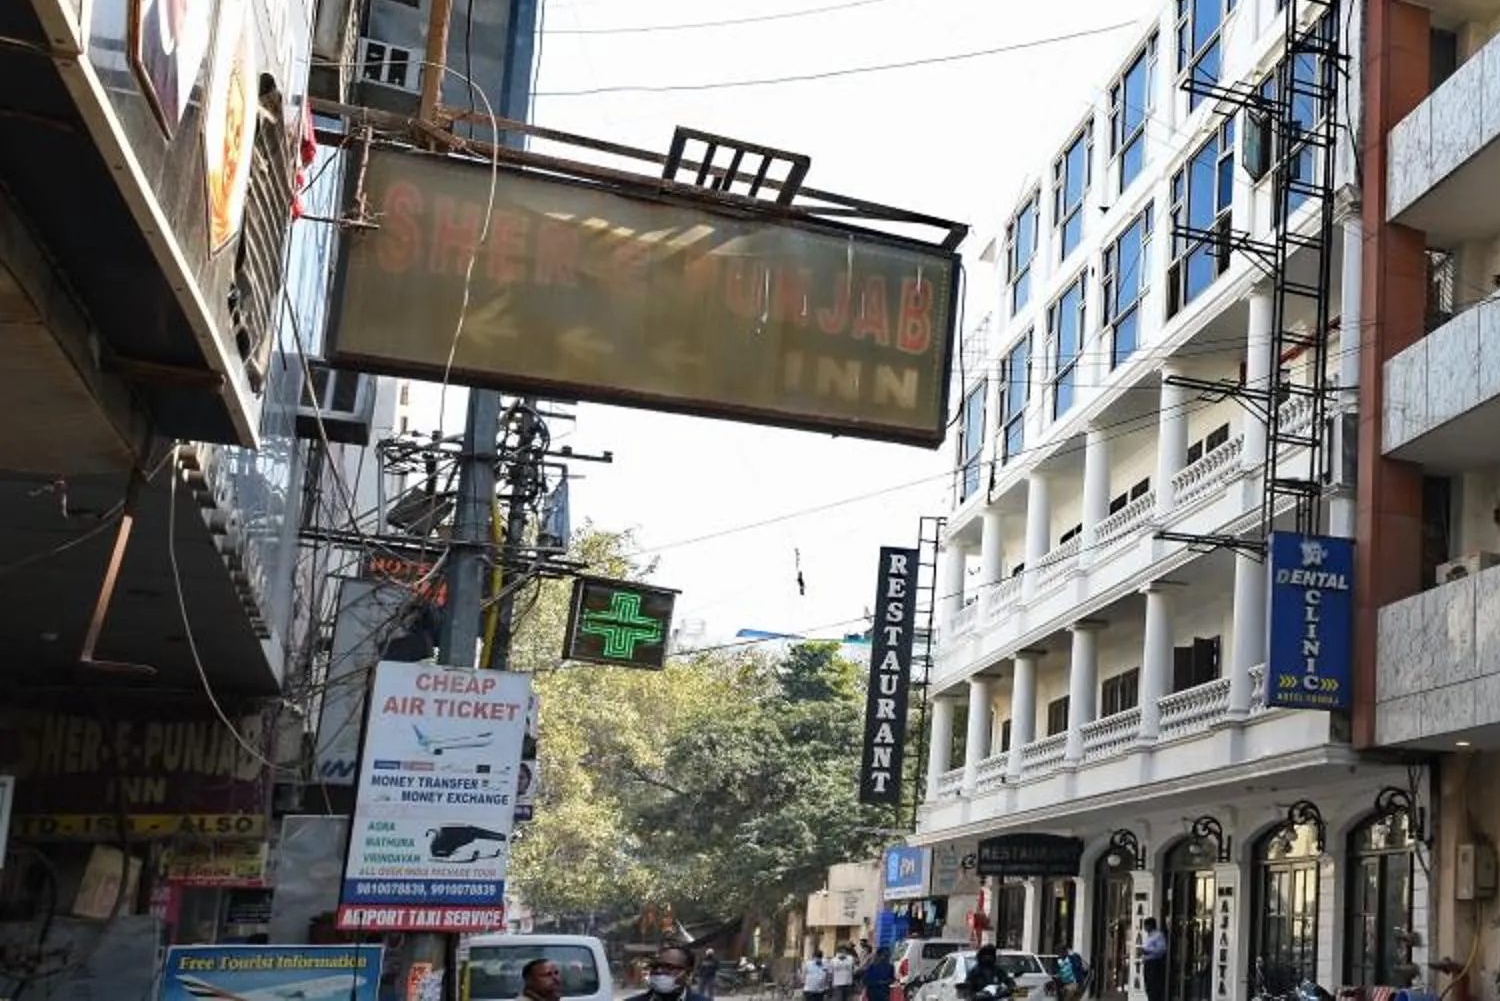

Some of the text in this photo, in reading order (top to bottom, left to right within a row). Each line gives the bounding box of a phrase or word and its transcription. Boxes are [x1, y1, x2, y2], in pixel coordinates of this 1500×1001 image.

[785, 352, 920, 409] INN
[1276, 568, 1349, 590] DENTAL
[1302, 590, 1321, 691] CLINIC
[872, 554, 908, 792] RESTAURANT
[415, 673, 497, 696] CHEAP
[383, 696, 521, 721] AIR TICKET
[372, 775, 479, 790] MONEY TRANSFER
[402, 791, 510, 806] MONEY EXCHANGE
[408, 909, 441, 927] TAXI
[443, 909, 500, 927] SERVICE
[179, 954, 367, 970] Free Tourist Information
